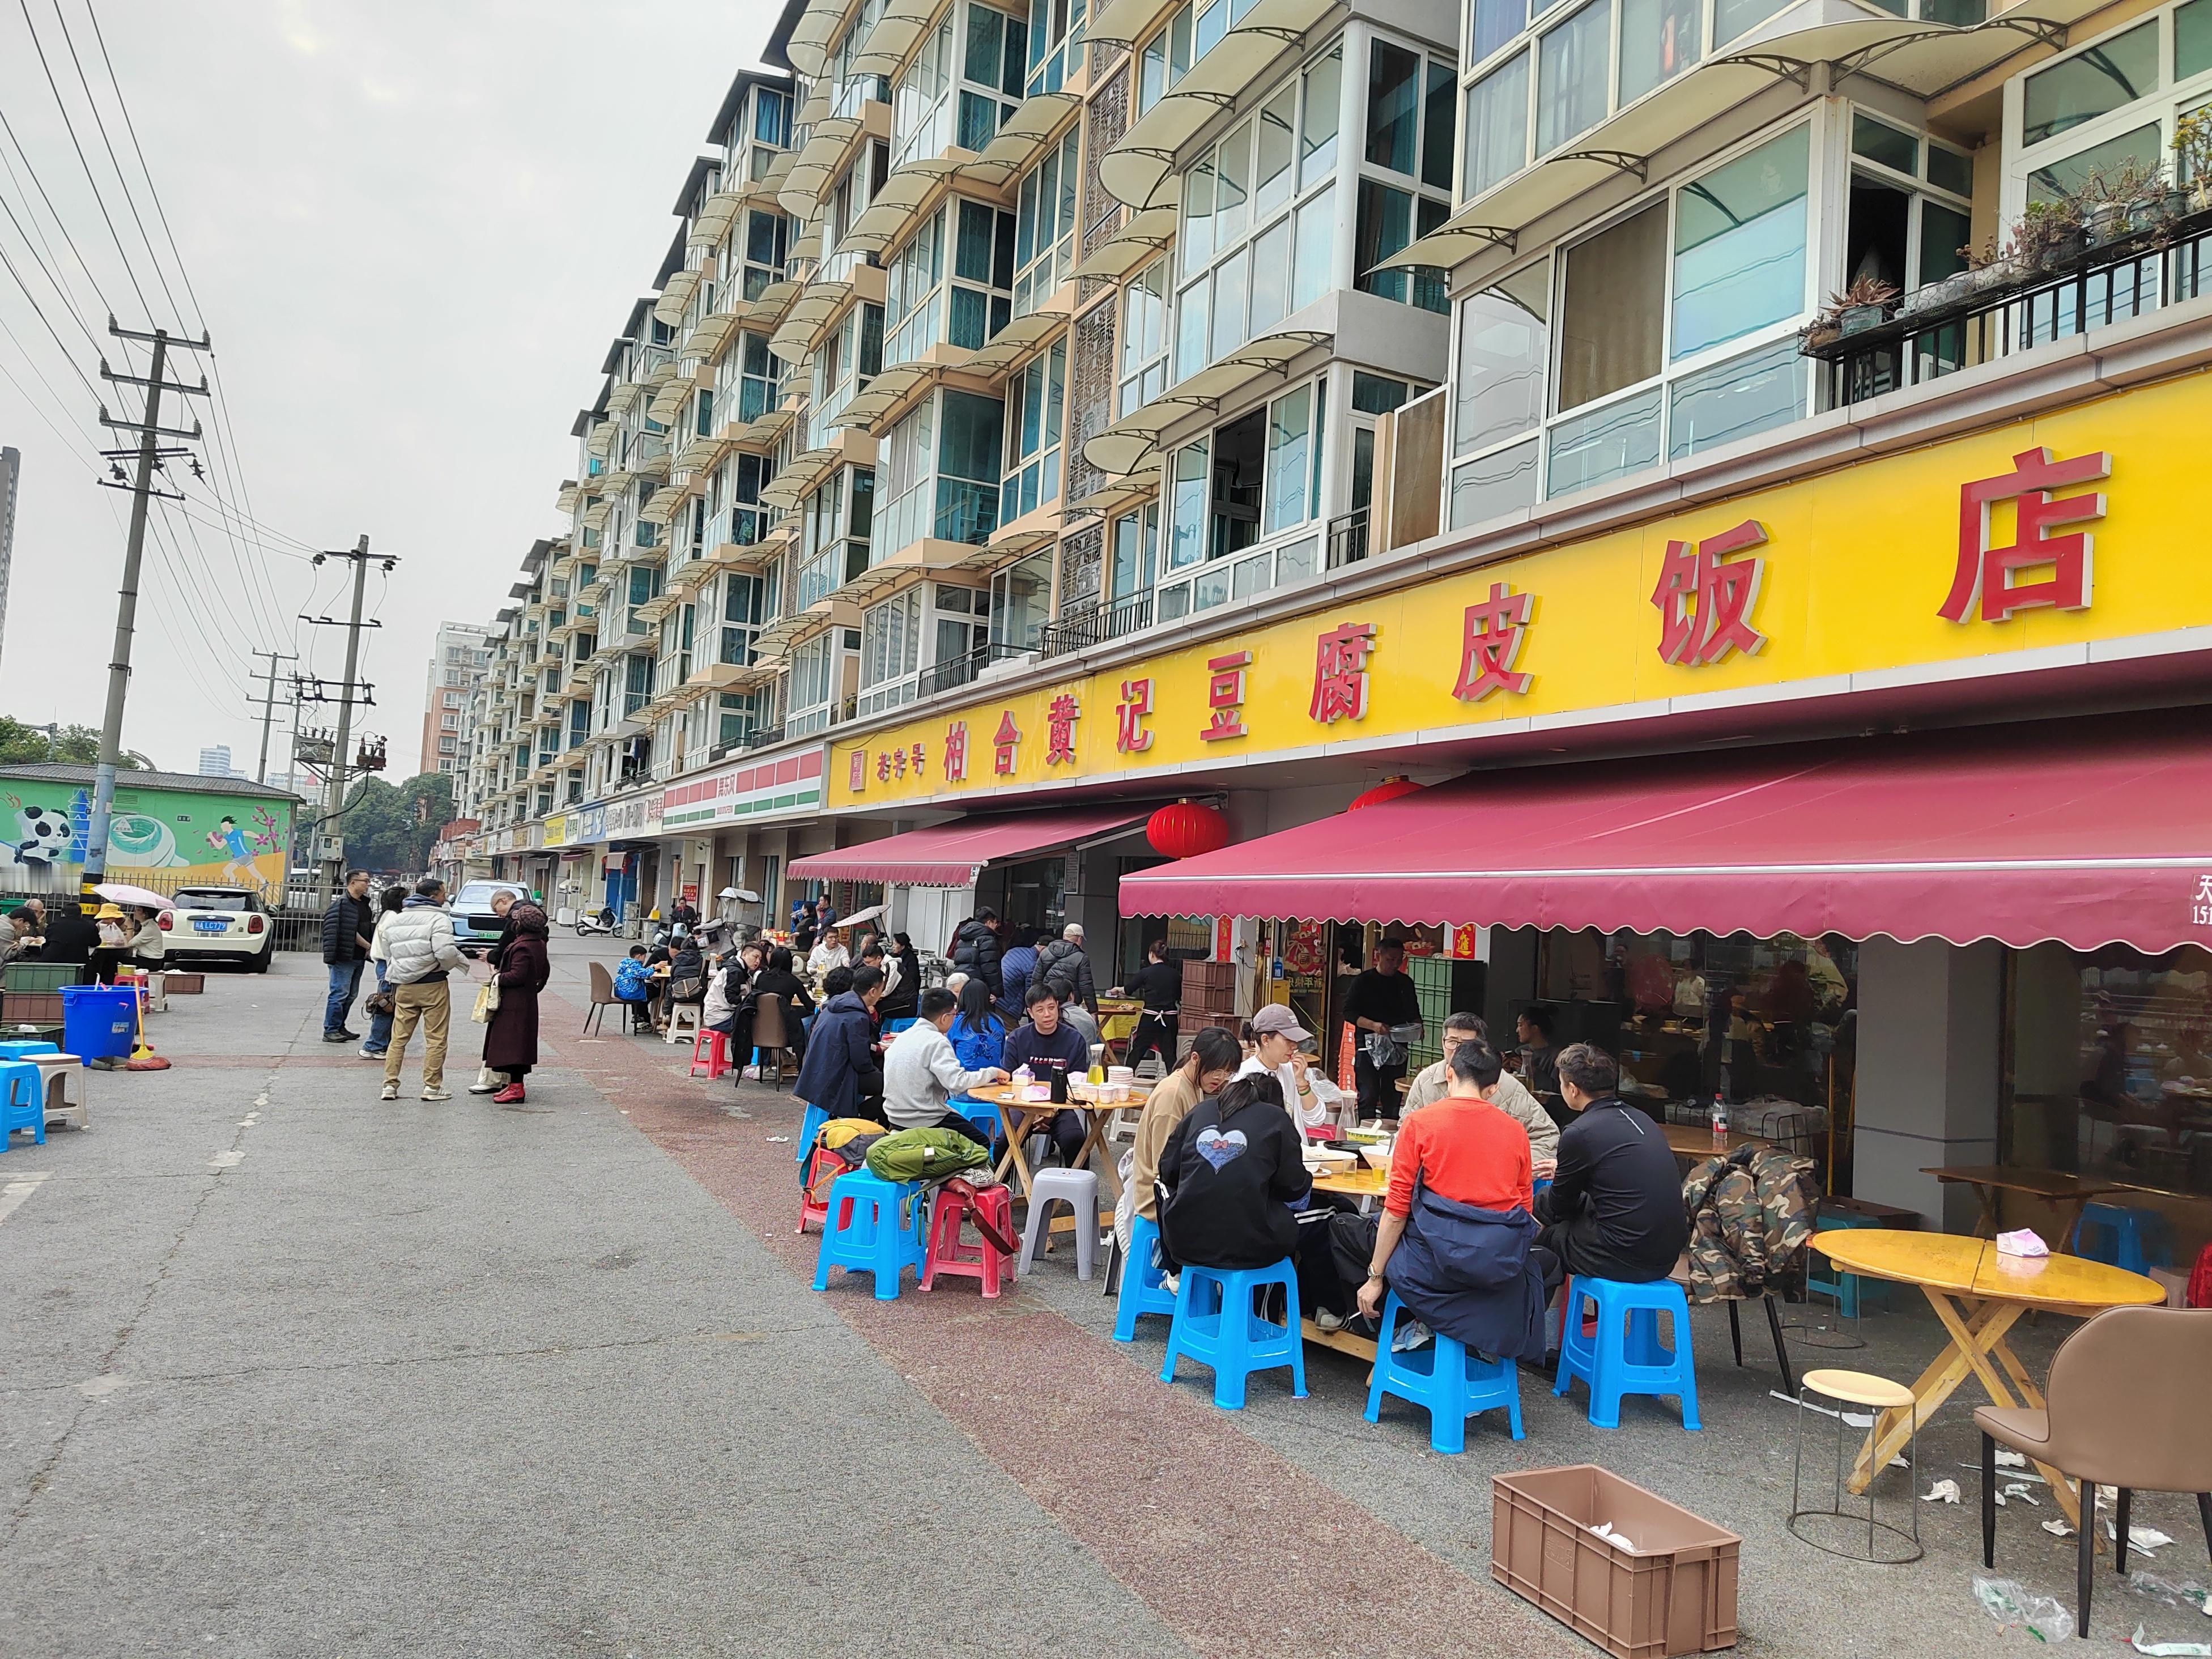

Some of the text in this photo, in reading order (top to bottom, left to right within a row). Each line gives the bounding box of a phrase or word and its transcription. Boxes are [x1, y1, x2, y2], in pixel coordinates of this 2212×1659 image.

[877, 446, 2112, 781] 老字号 柏合黄记豆腐皮饭店
